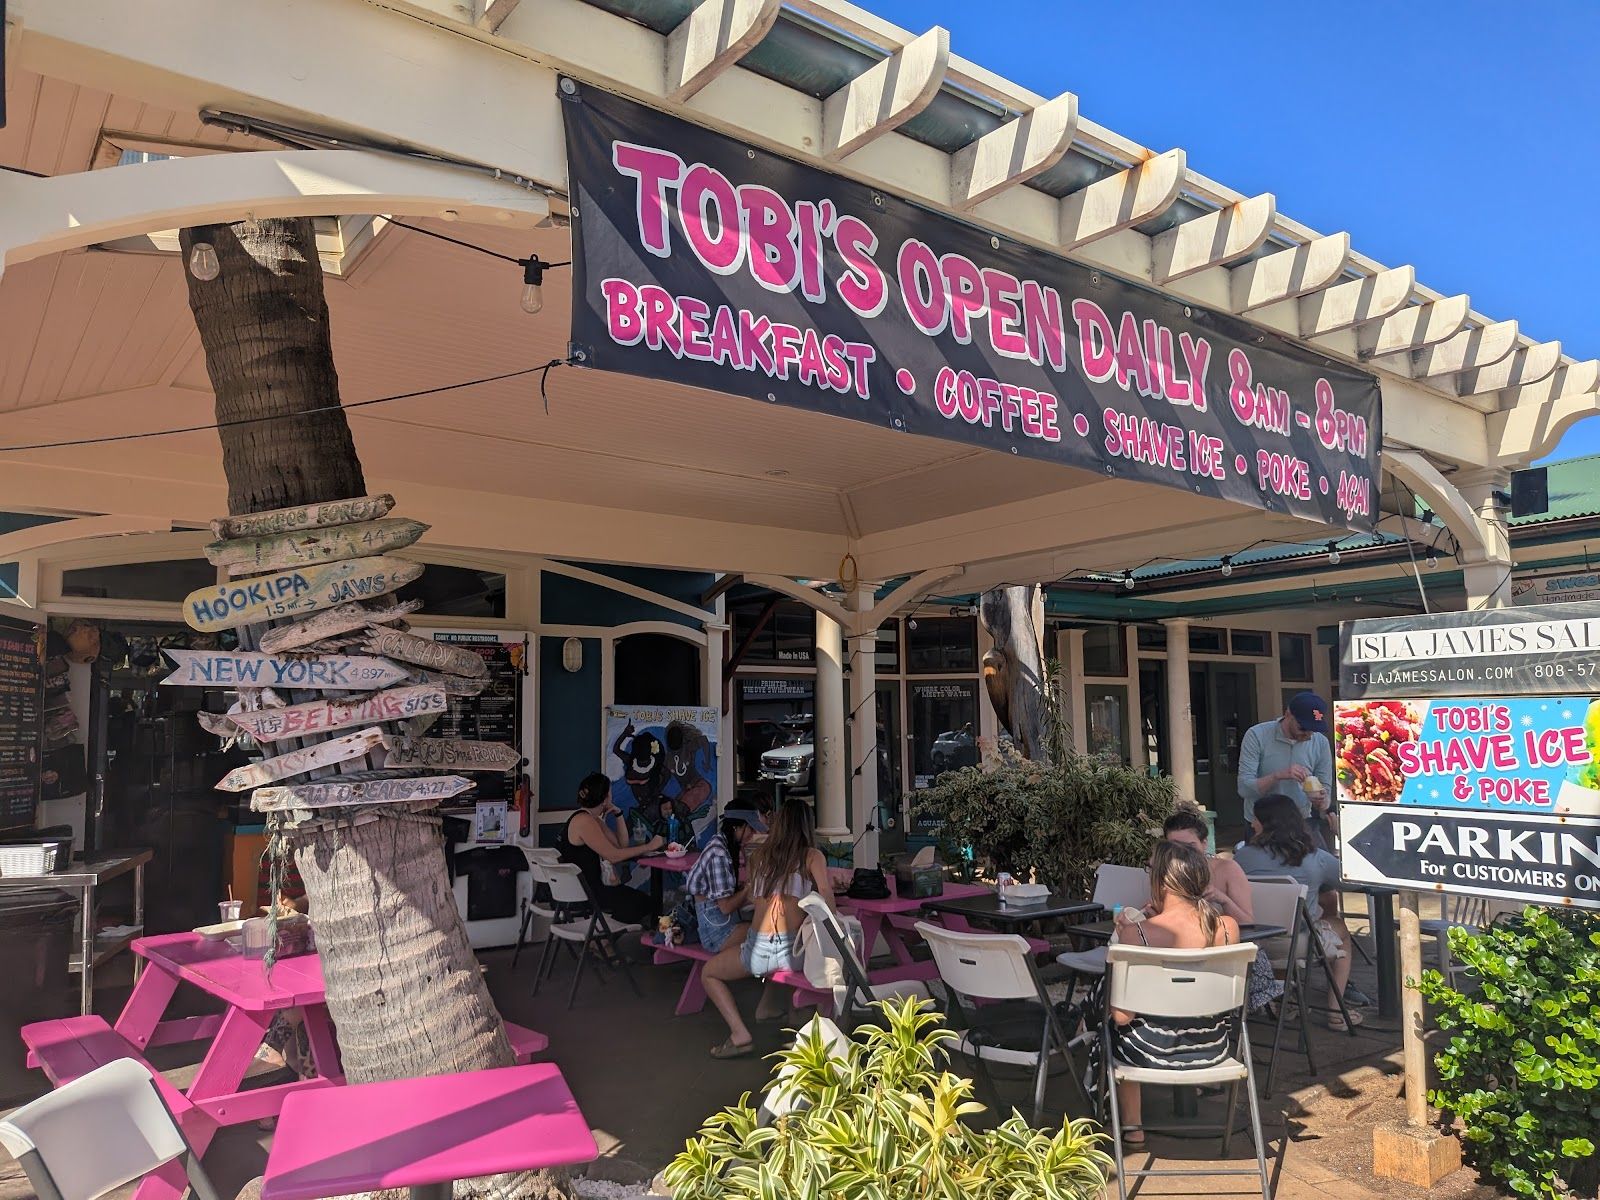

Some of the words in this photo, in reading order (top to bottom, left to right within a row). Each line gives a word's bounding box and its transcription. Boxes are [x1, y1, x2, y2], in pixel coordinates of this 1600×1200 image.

[612, 140, 888, 318] TOBI'S
[897, 237, 1067, 373] OPEN
[1072, 299, 1211, 412] DAILY
[1227, 348, 1291, 436] 8AM
[1314, 378, 1367, 459] 8PM
[601, 278, 875, 399] BREAKFAST
[934, 366, 1062, 443] COFFEE
[1102, 407, 1186, 473] SHAVE
[1189, 430, 1226, 481] ICE
[1256, 449, 1312, 501] POKE
[1336, 470, 1370, 521] AÇAI
[328, 574, 386, 602] JAWS
[1541, 591, 1595, 603] Handmade
[265, 602, 286, 617] 1.5
[381, 632, 453, 667] CALGARY
[1355, 634, 1417, 660] ISLA
[1425, 625, 1527, 656] JAMES
[1536, 621, 1600, 650] SAL
[778, 651, 793, 660] Made
[799, 651, 810, 660] USA
[188, 657, 264, 683] NEW
[269, 659, 350, 685] YORK
[1352, 666, 1514, 685] ISLAJAMESSALON.COM
[1534, 663, 1597, 678] 808-57
[254, 715, 282, 735] 北京
[280, 694, 403, 736] BEIJING
[1432, 705, 1512, 733] TOBI'S
[1399, 734, 1517, 775] SHAVE
[1526, 726, 1591, 766] ICE
[1452, 778, 1474, 800] &
[1478, 777, 1551, 805] POKE
[1420, 859, 1446, 877] For
[1453, 861, 1567, 889] CUSTOMERS
